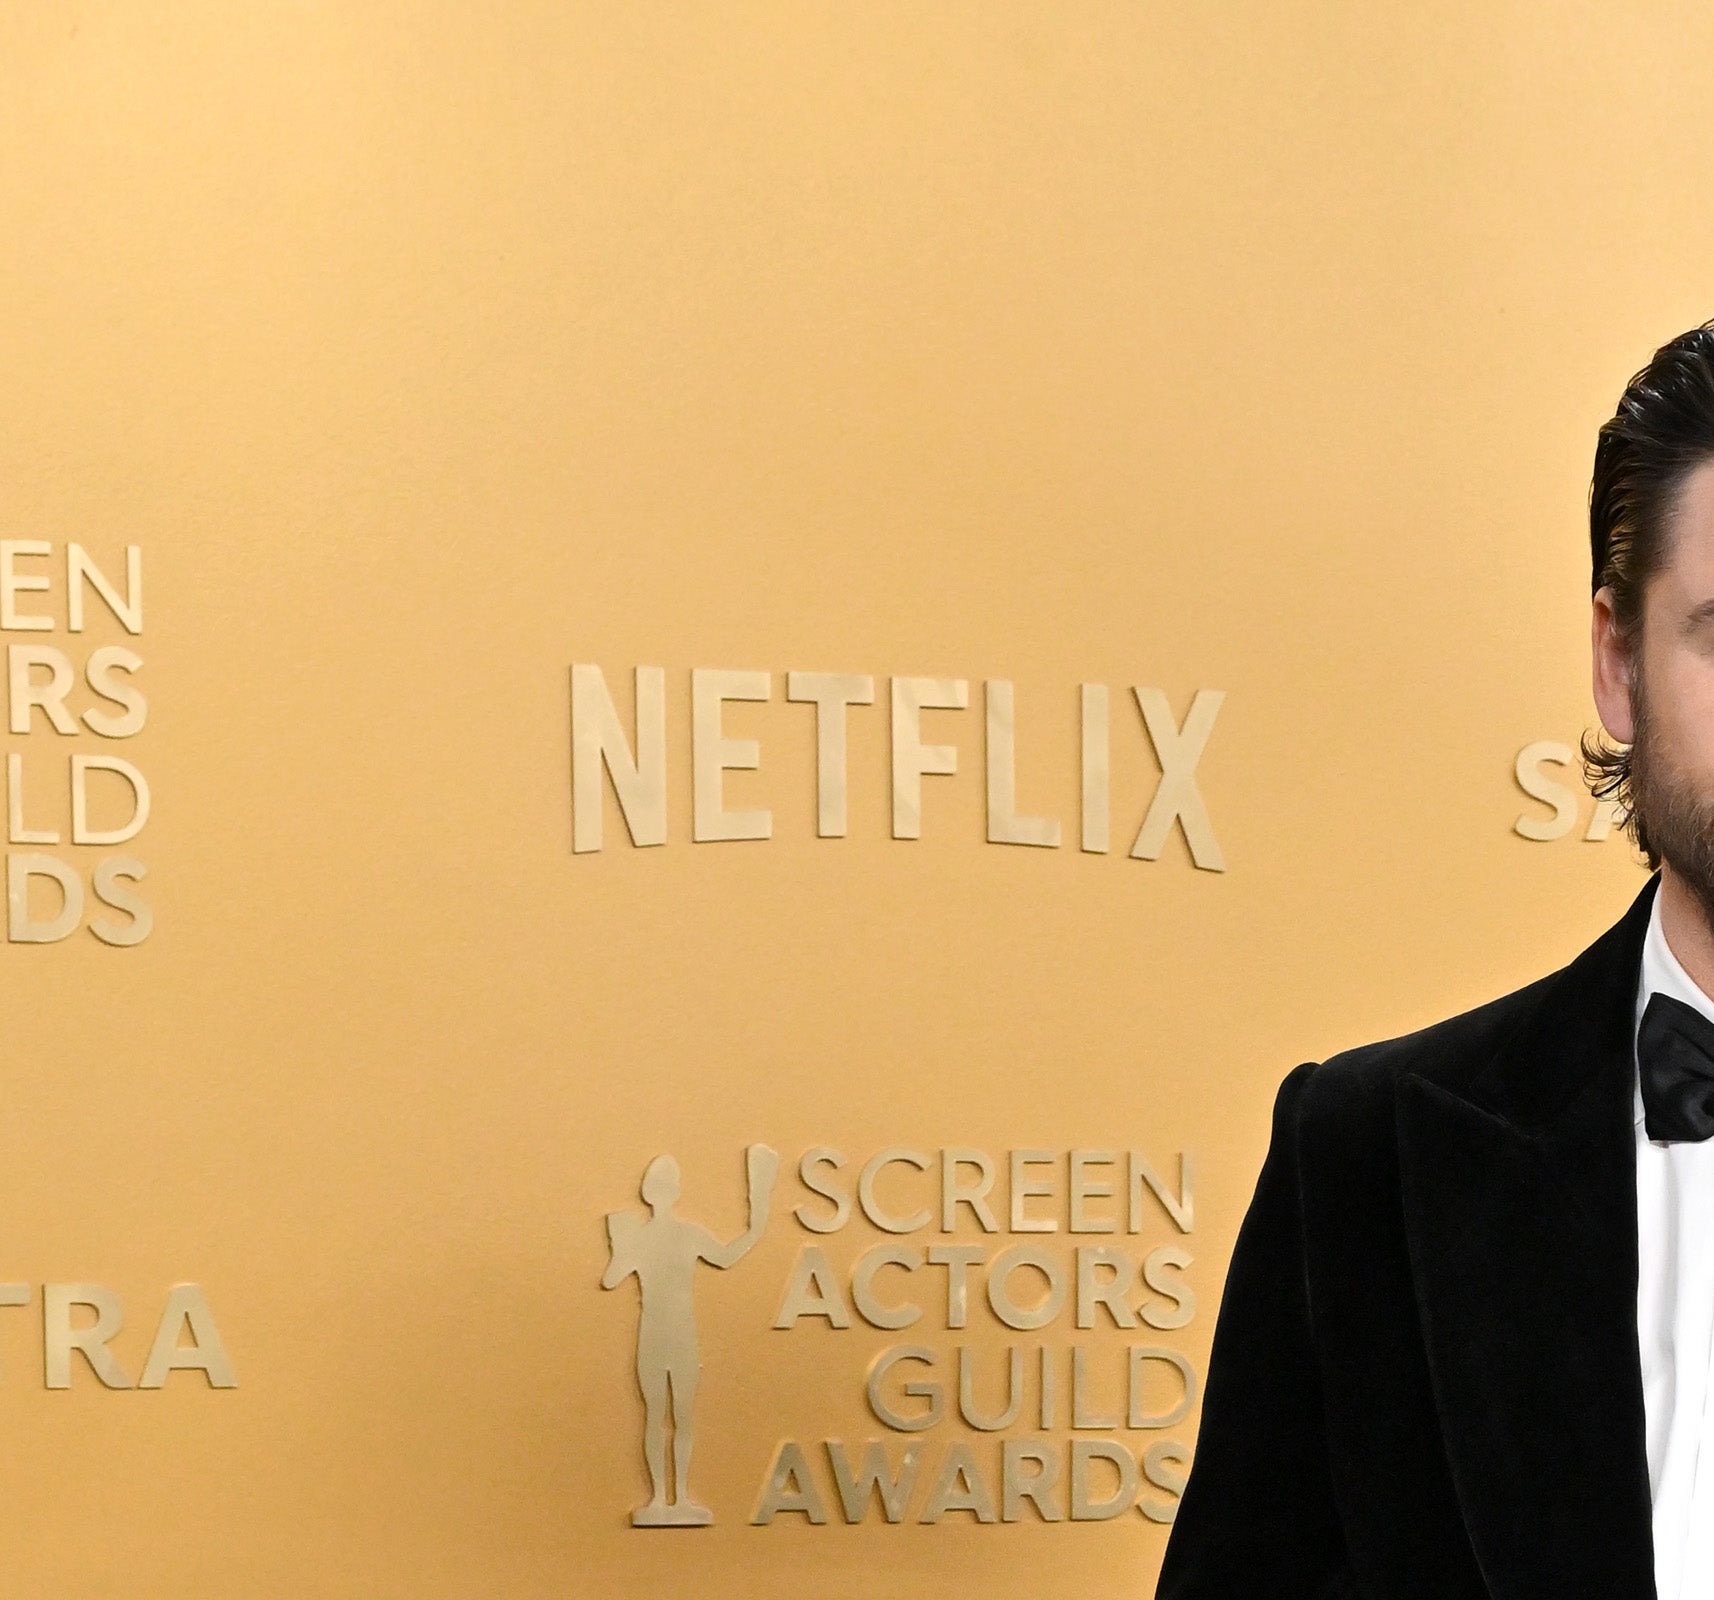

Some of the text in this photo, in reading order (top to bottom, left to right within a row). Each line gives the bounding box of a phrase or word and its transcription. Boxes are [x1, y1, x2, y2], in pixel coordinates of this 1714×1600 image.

[0, 538, 144, 635] EN
[7, 643, 148, 739] RS
[7, 752, 151, 846] LD
[569, 662, 1229, 874] NETFLIX
[794, 1147, 1196, 1234] SCREEN
[773, 1246, 1197, 1330] ACTORS
[866, 1346, 1199, 1433] GUILD
[751, 1439, 1194, 1525] AWARDS
